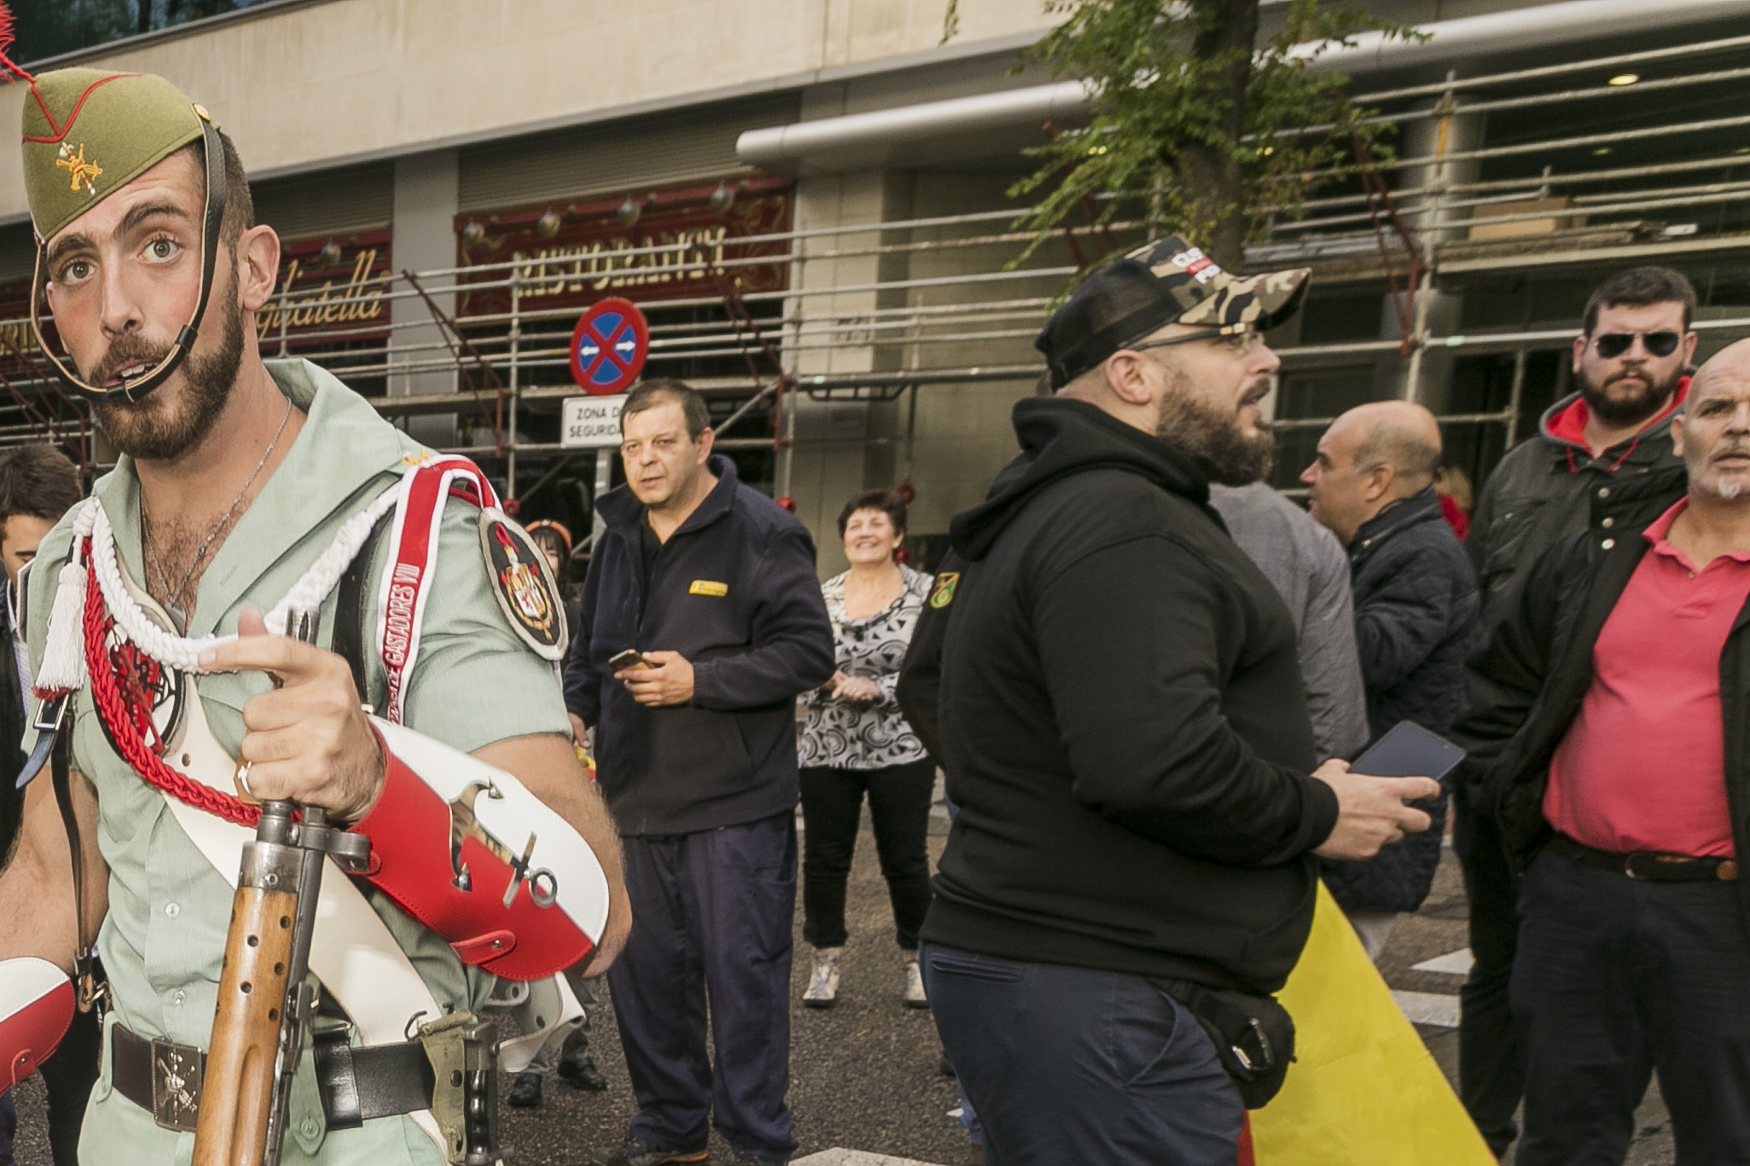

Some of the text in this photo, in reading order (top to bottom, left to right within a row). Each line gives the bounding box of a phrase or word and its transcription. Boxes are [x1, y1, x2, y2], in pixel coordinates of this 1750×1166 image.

[255, 248, 384, 341] gliatella
[569, 423, 622, 438] SEGURID
[576, 405, 622, 420] ZONA D
[384, 583, 415, 666] GASTADORES
